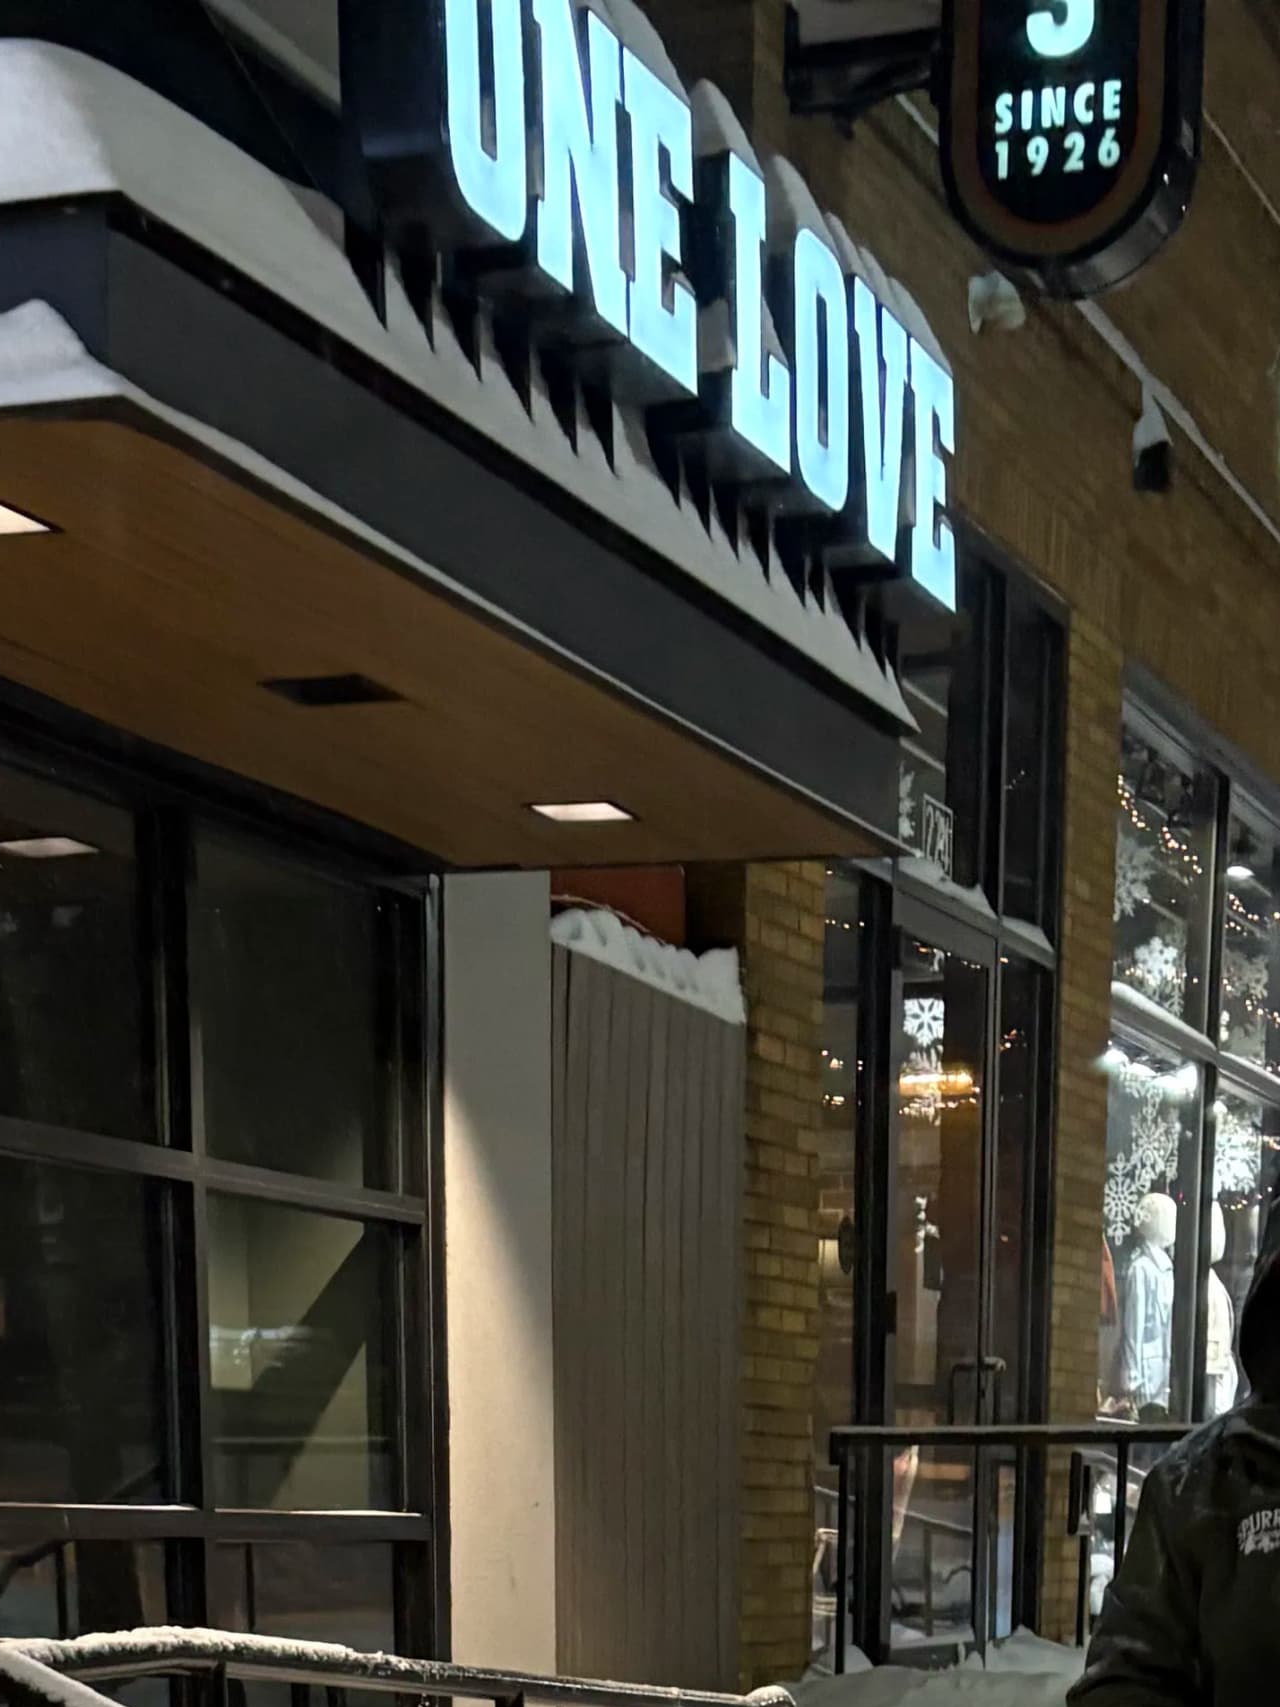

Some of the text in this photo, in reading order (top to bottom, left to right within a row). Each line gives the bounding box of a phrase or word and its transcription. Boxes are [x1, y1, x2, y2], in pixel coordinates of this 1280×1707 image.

[995, 80, 1122, 134] SINCE
[995, 127, 1121, 181] 1926
[445, 0, 956, 613] ONE LOVE
